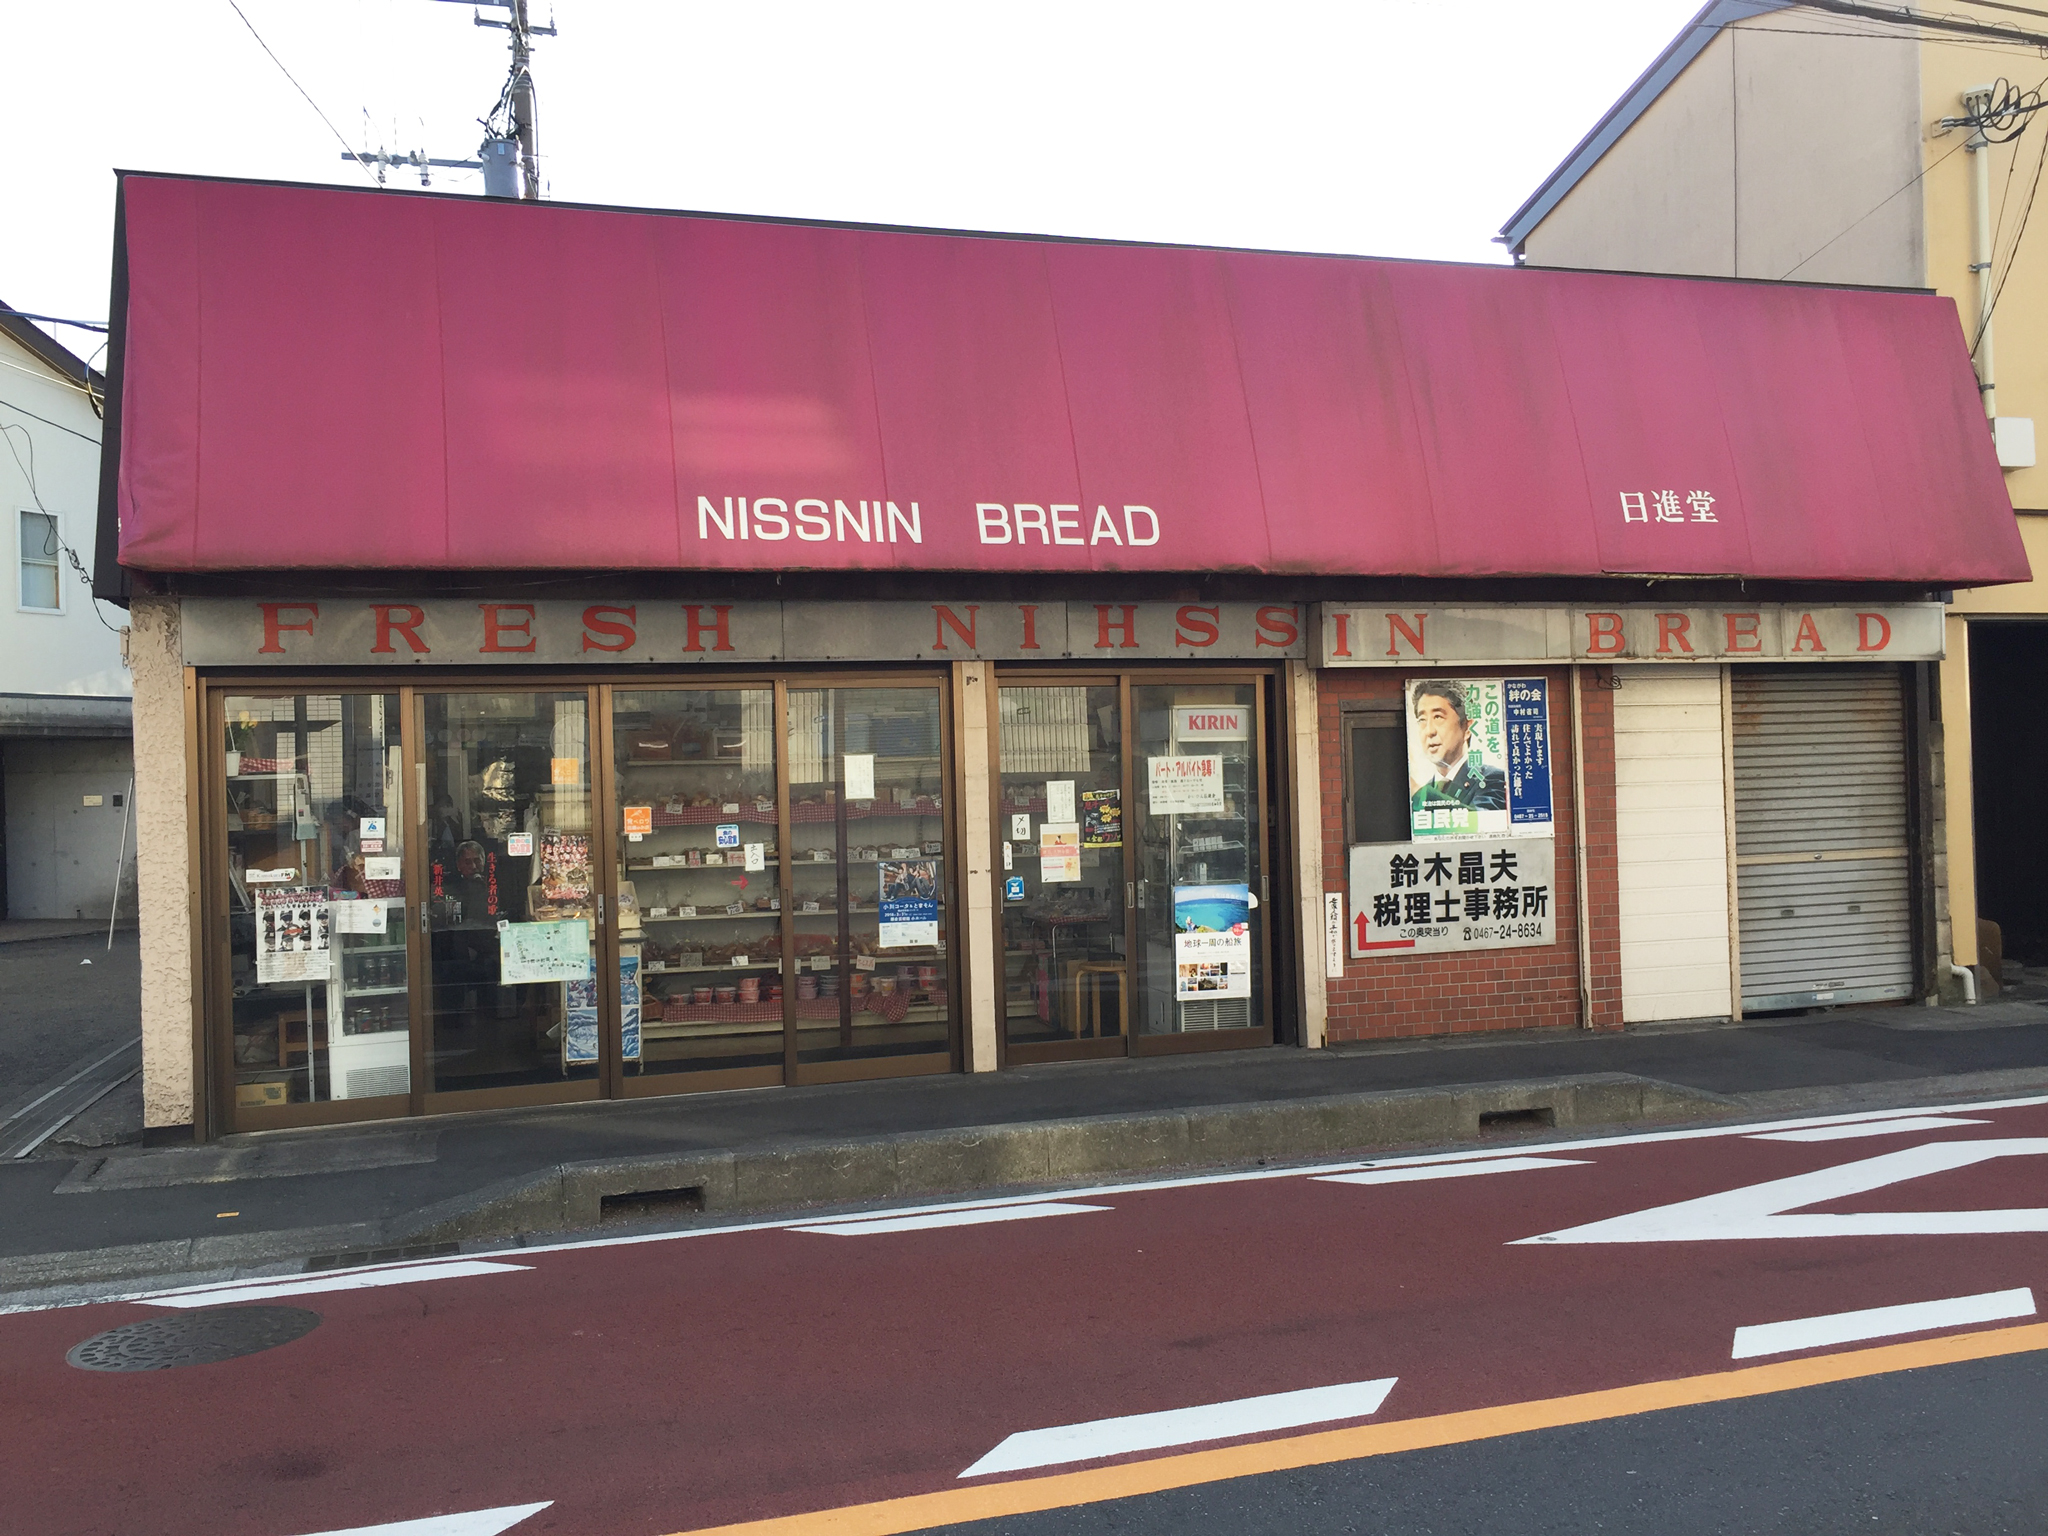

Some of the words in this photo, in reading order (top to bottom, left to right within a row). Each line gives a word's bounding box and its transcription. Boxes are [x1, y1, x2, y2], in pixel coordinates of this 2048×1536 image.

[697, 495, 923, 543] NISSNIN
[976, 503, 1160, 546] BREAD
[1619, 489, 1719, 523] 日進堂
[256, 602, 735, 654] FRESH
[1587, 612, 1891, 653] BREAD
[1508, 688, 1542, 702] 絆の会
[1188, 715, 1238, 730] KIRIN
[1466, 684, 1487, 789] 力強く、前へ。
[1485, 684, 1502, 760] この道を。
[1413, 807, 1469, 830] 自民党
[1389, 849, 1518, 888] 鈴木晶夫
[1373, 885, 1549, 928] 税理士事務所
[1184, 937, 1242, 949] 地球一周の船旅
[1399, 926, 1449, 938] この奥突当り
[1473, 922, 1542, 940] 0467-24-8634
